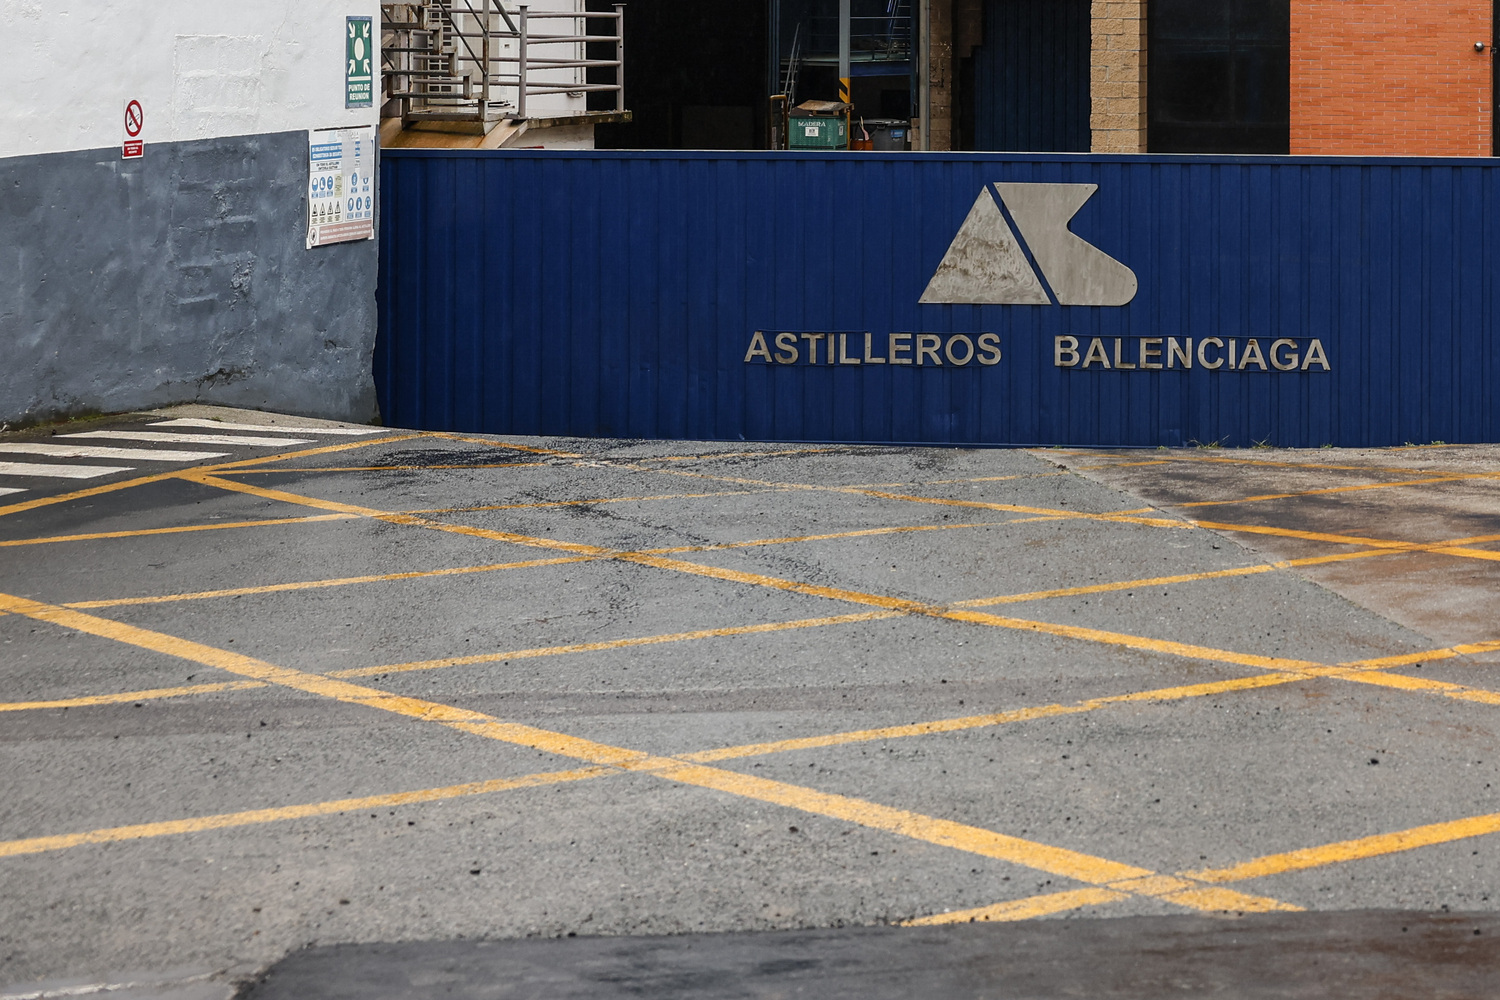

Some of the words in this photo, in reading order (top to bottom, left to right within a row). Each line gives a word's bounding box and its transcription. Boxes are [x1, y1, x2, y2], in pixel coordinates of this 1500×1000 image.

[348, 83, 363, 91] PUNTO
[364, 83, 370, 91] DE
[744, 331, 1002, 366] ASTILLEROS
[1054, 335, 1331, 371] BALENCIAGA
